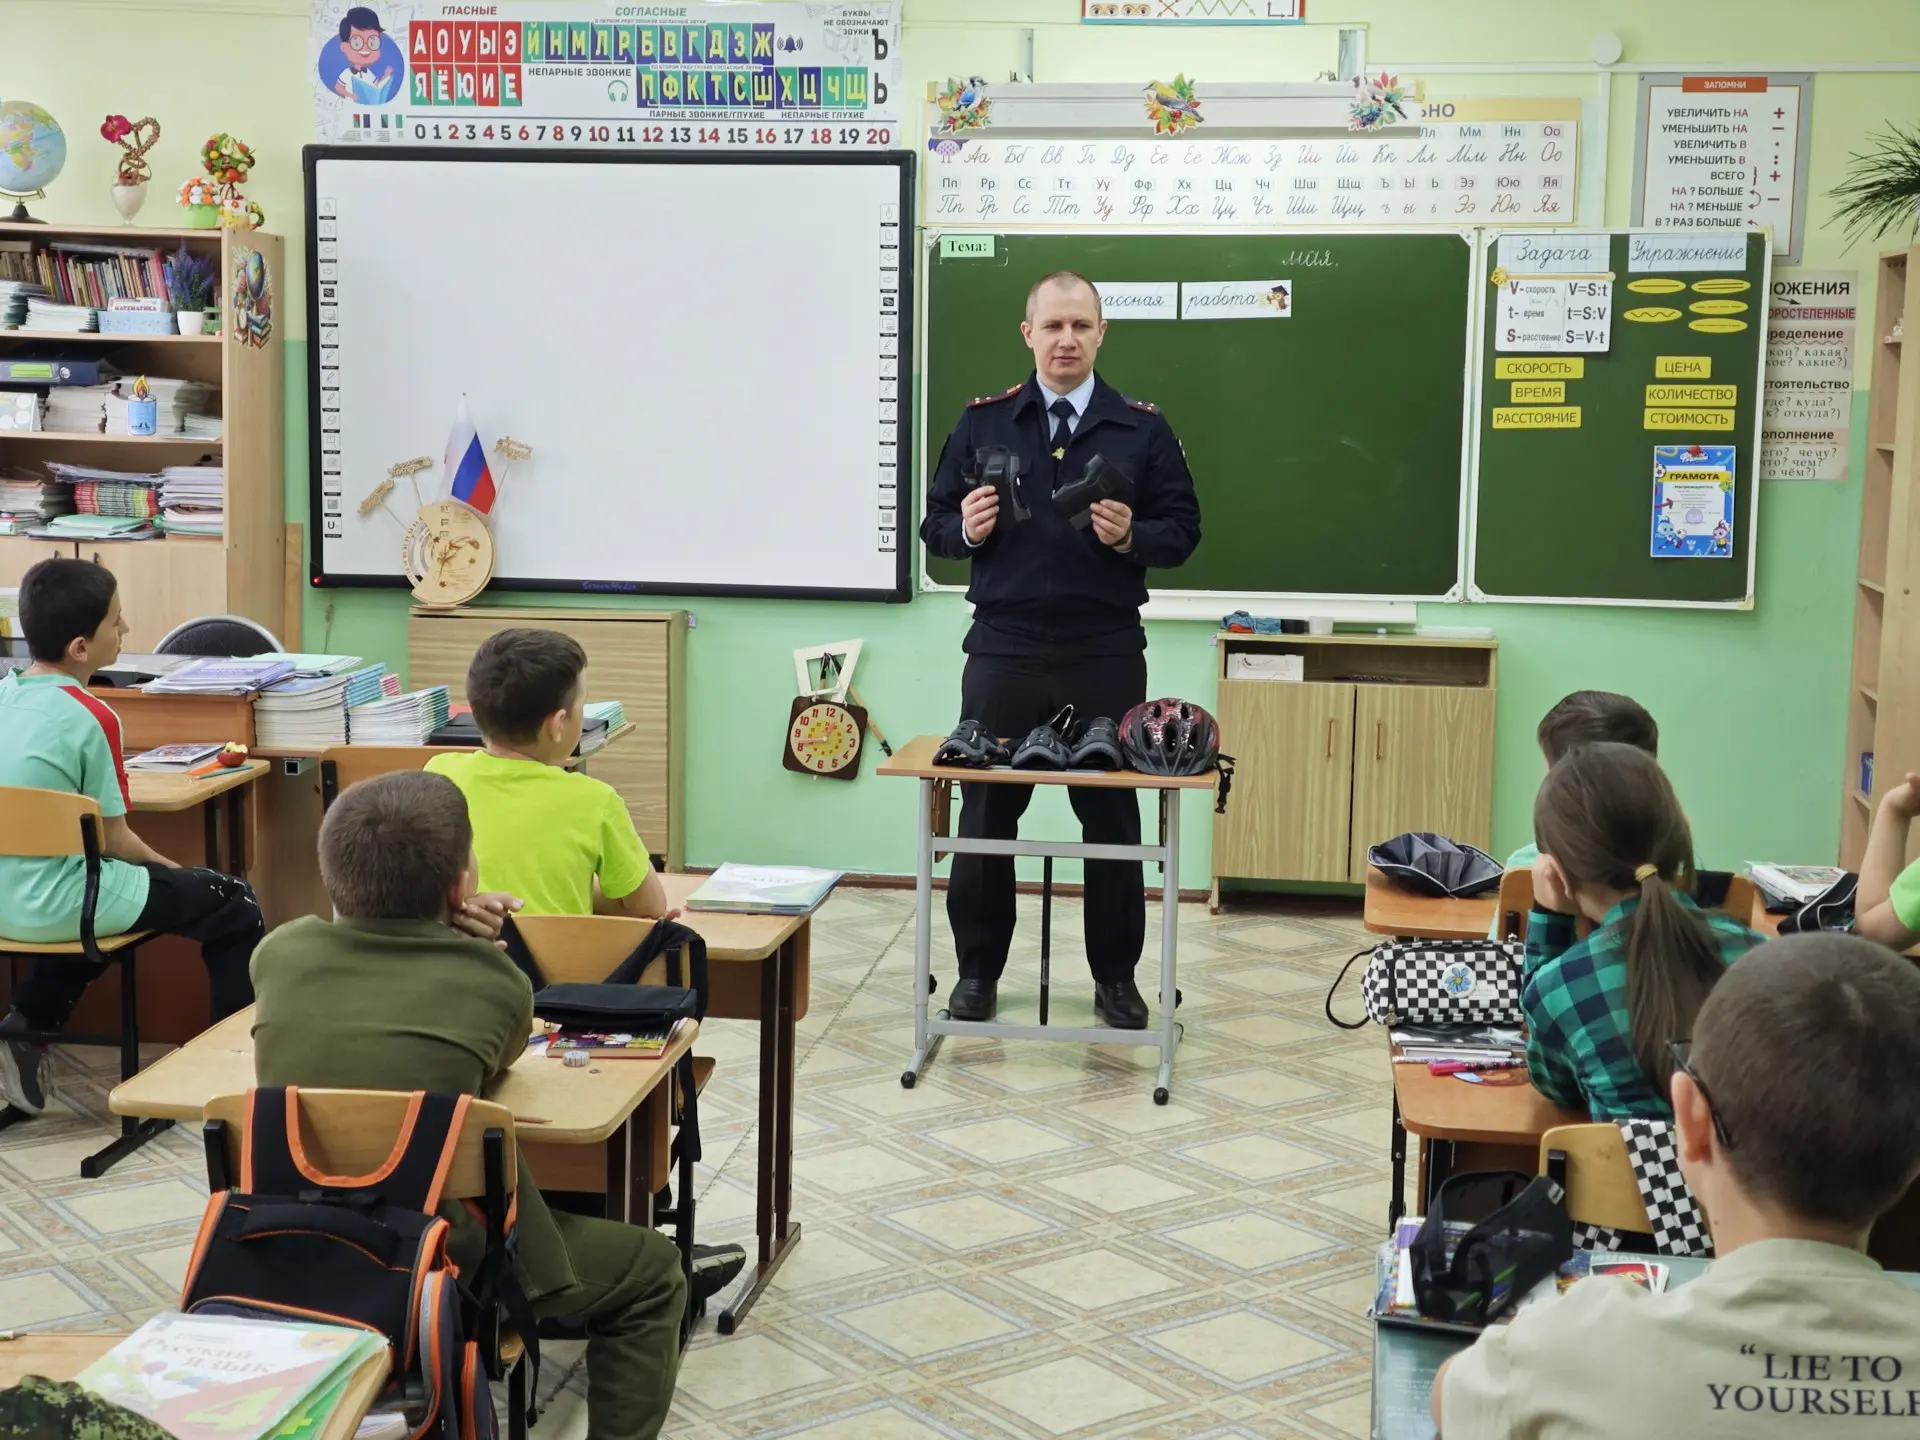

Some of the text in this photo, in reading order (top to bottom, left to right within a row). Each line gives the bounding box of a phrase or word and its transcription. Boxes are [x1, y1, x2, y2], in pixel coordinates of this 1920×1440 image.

[442, 5, 498, 16] ГЛАСНЫЕ
[615, 6, 687, 17] СОГЛАСНЫЕ
[836, 19, 889, 27] ОБОЗНАЧАЮТ
[528, 68, 632, 77] НЕПАРНЫЕ ЗВОНКИЕ
[1704, 81, 1747, 89] ЗАПОМНИ
[650, 110, 765, 119] ПАРНЫЕ ЗВОНКИЕ/ГЛУХИЕ
[781, 111, 865, 119] НЕПАРНЫЕ ГЛУХИЕ
[1667, 108, 1748, 118] УВЕЛИЧИТЬ НА
[1459, 127, 1481, 137] Мм
[1504, 127, 1521, 136] Нн
[1543, 126, 1560, 136] Оо
[1662, 124, 1747, 133] УМЕНЬШИТЬ НА
[415, 125, 426, 140] 0
[433, 125, 442, 140] 1
[448, 125, 459, 140] 2
[466, 125, 476, 140] 3
[483, 125, 494, 140] 4
[501, 125, 512, 140] 5
[519, 126, 529, 141] 6
[536, 126, 546, 141] 7
[553, 126, 564, 141] 8
[571, 126, 582, 141] 9
[589, 126, 610, 142] 10
[617, 127, 635, 142] 11
[642, 127, 663, 142] 12
[670, 127, 691, 142] 13
[698, 127, 720, 143] 14
[728, 127, 748, 143] 15
[755, 128, 776, 143] 16
[784, 128, 804, 143] 17
[811, 128, 831, 144] 18
[839, 128, 859, 144] 19
[867, 129, 890, 145] 20
[1674, 140, 1747, 149] УВЕЛИЧИТЬ В
[964, 146, 990, 163] Аа
[1668, 156, 1745, 165] УМЕНЬШИТЬ В
[1710, 172, 1745, 180] ВСЕГО
[942, 178, 958, 191] Пп
[981, 178, 996, 192] Рр
[1018, 178, 1032, 190] Сс
[1058, 178, 1071, 189] Тт
[1096, 179, 1110, 191] Уу
[1134, 177, 1152, 191] Фф
[1178, 178, 1191, 190] Хх
[1215, 178, 1232, 192] Цц
[1255, 179, 1270, 189] Чч
[1294, 179, 1316, 189] Шш
[1338, 179, 1361, 191] Щщ
[1460, 177, 1474, 188] Ээ
[1497, 177, 1520, 187] Юю
[1542, 177, 1558, 187] Яя
[1672, 187, 1744, 195] НА ? БОЛЬШЕ
[1670, 203, 1743, 211] НА ? МЕНЬШЕ
[1655, 218, 1742, 227] В ? РАЗ БОЛЬШЕ
[947, 240, 988, 253] Тема:
[1516, 239, 1592, 269] Задача
[1631, 239, 1745, 270] Упражнение
[1525, 286, 1556, 295] скорость
[1770, 282, 1849, 295] ОЖЕНИЯ
[1100, 286, 1258, 314] ассная работа
[1524, 310, 1544, 319] время
[1767, 330, 1843, 340] ределение
[1506, 362, 1572, 375] СКОРОСТЬ
[1664, 362, 1702, 375] ЦЕНА
[1515, 387, 1562, 398] ВРЕМЯ
[1648, 388, 1734, 401] КОЛИЧЕСТВО
[1496, 412, 1577, 424] РАССТОЯНИЕ
[1650, 412, 1728, 425] СТОИМОСТЬ
[812, 709, 818, 718] 11
[826, 708, 836, 717] 12
[840, 713, 844, 722] 1
[800, 716, 809, 726] 10
[795, 728, 801, 738] 9
[847, 724, 853, 733] 2
[798, 743, 804, 752] 8
[849, 738, 855, 748] 3
[806, 754, 812, 763] 7
[843, 751, 849, 760] 4
[817, 760, 823, 769] 6
[832, 759, 838, 768] 5
[1841, 1355, 1902, 1382] TO
[182, 1385, 286, 1432] 4
